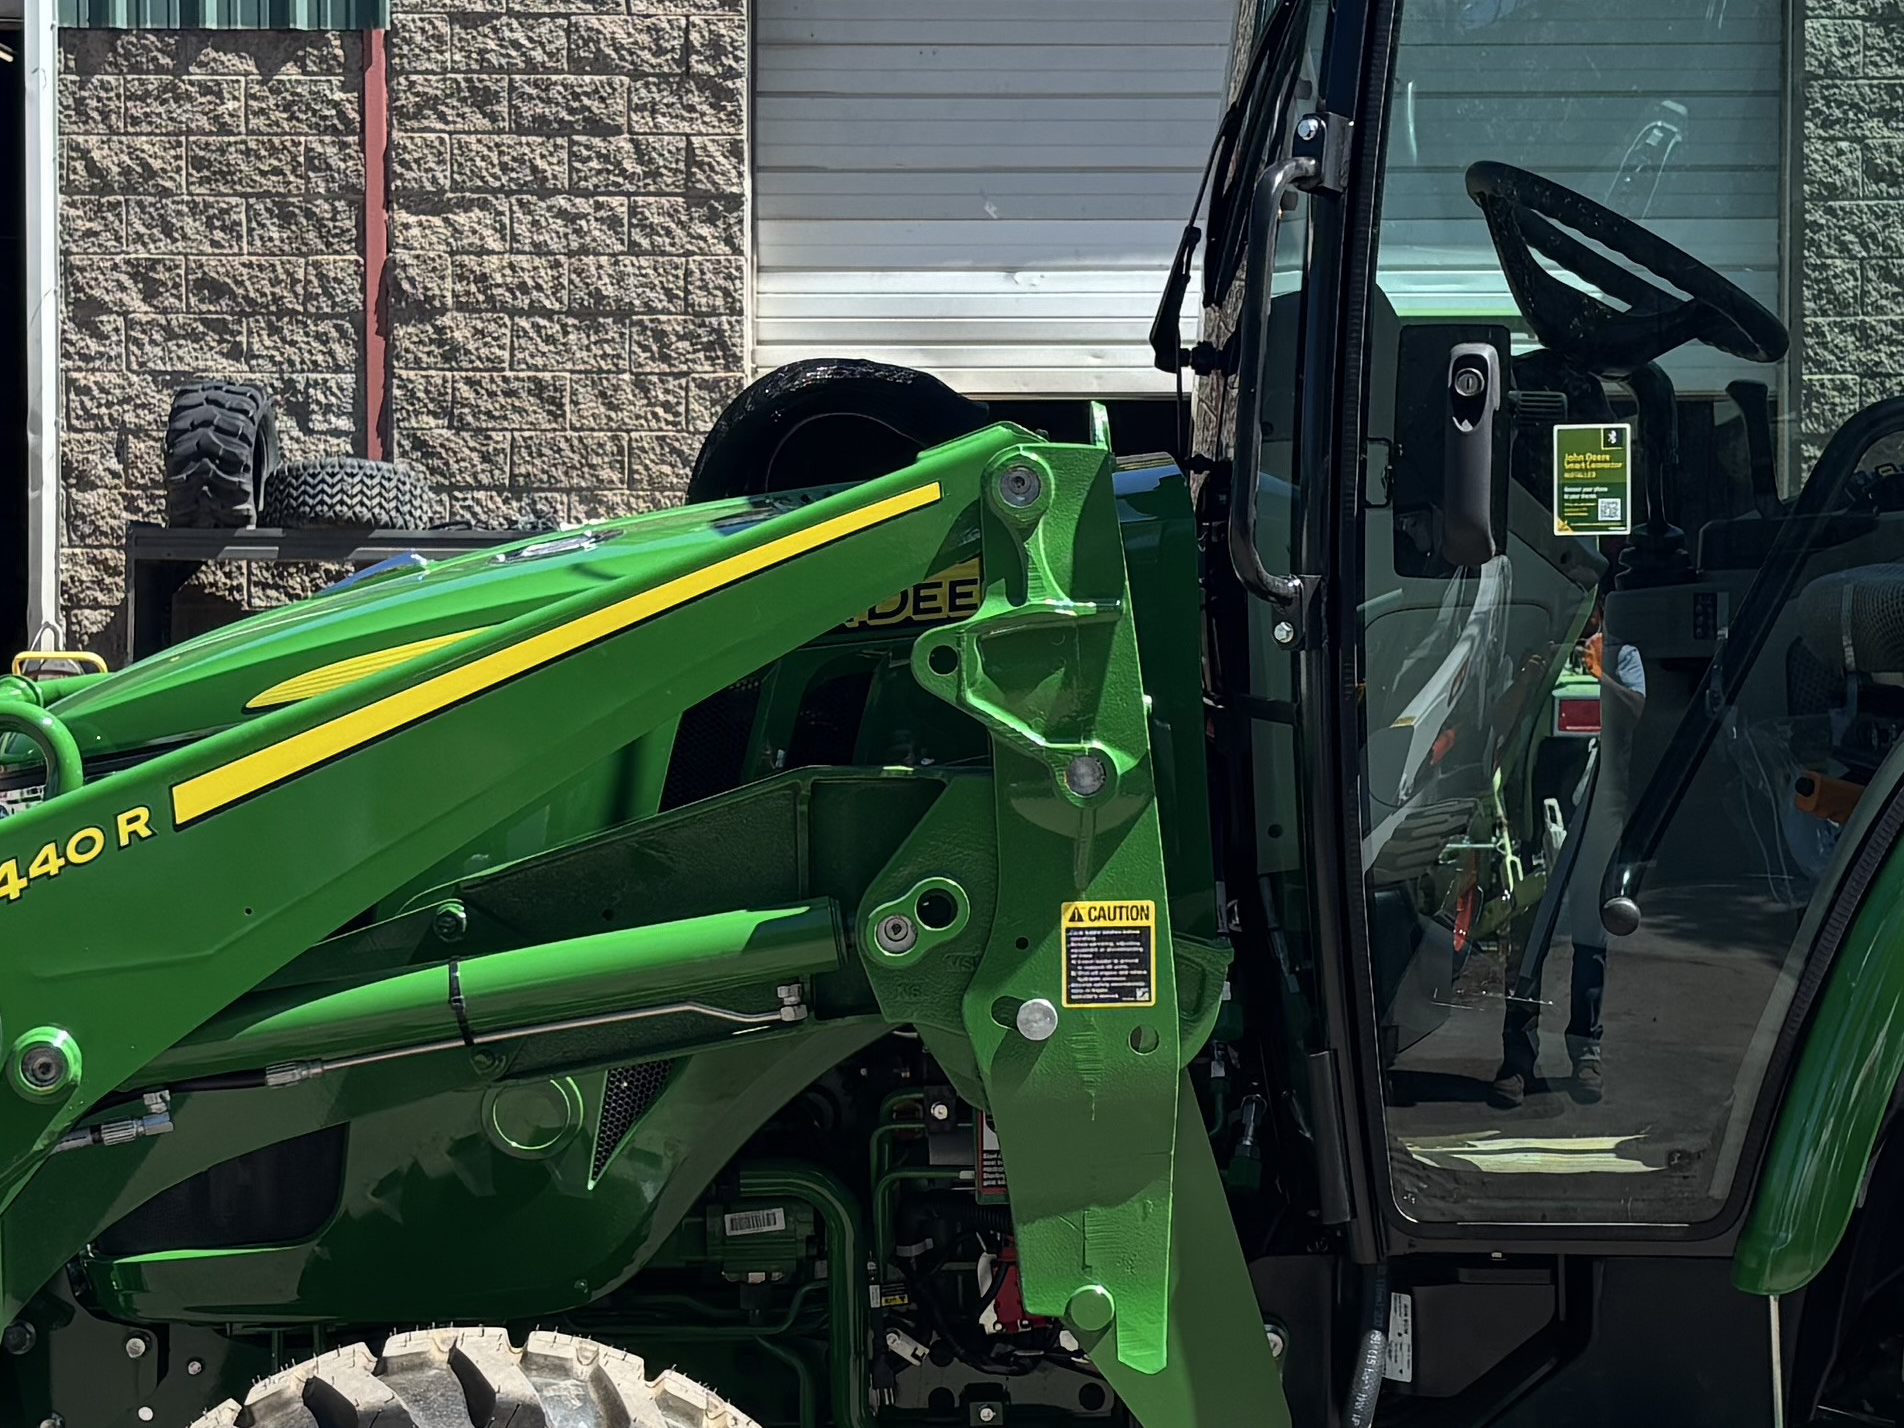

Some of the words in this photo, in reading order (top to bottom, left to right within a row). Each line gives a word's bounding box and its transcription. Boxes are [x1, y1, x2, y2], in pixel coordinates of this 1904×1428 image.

[868, 578, 979, 621] DEE
[116, 805, 156, 848] R
[1087, 904, 1150, 922] CAUTION
